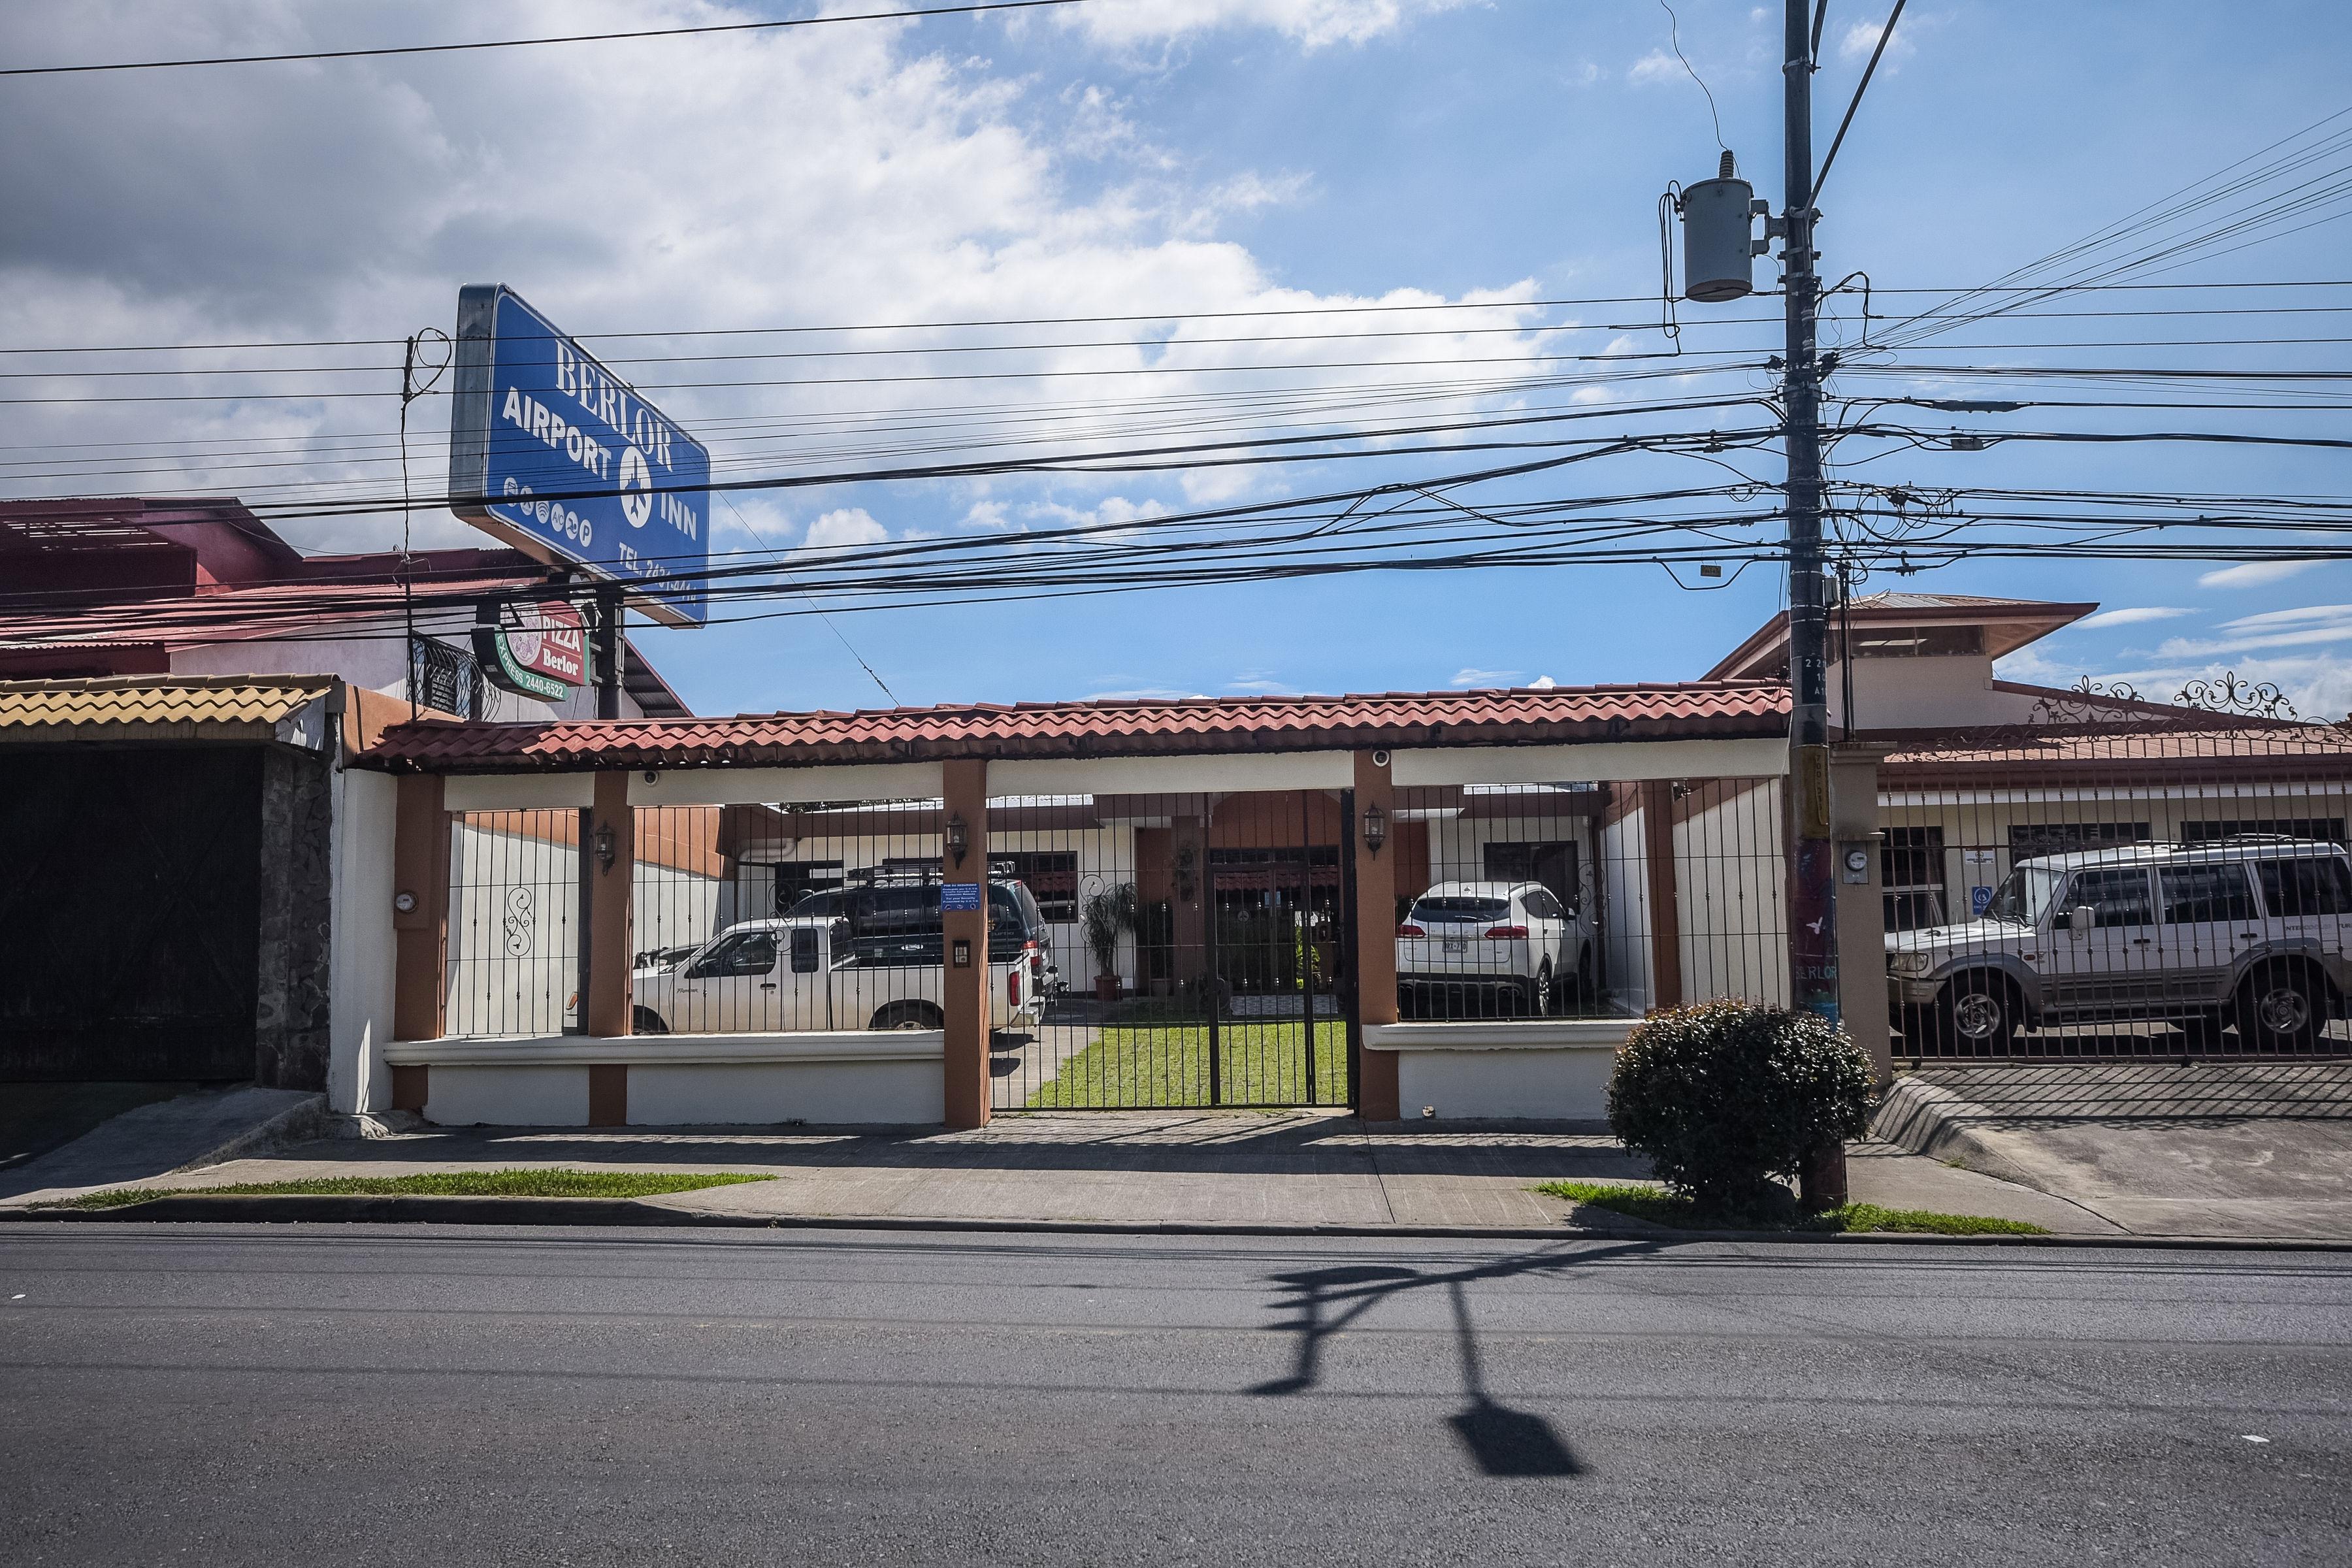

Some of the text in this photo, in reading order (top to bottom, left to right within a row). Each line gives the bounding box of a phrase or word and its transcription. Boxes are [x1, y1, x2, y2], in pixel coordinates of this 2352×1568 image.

[556, 338, 673, 472] BERLOR
[502, 386, 696, 541] AIRPORT INN
[553, 512, 564, 525] A/C
[543, 616, 580, 652] PIZZA
[497, 636, 563, 698] EXPRESS 2440-6522
[543, 648, 578, 676] Berlor
